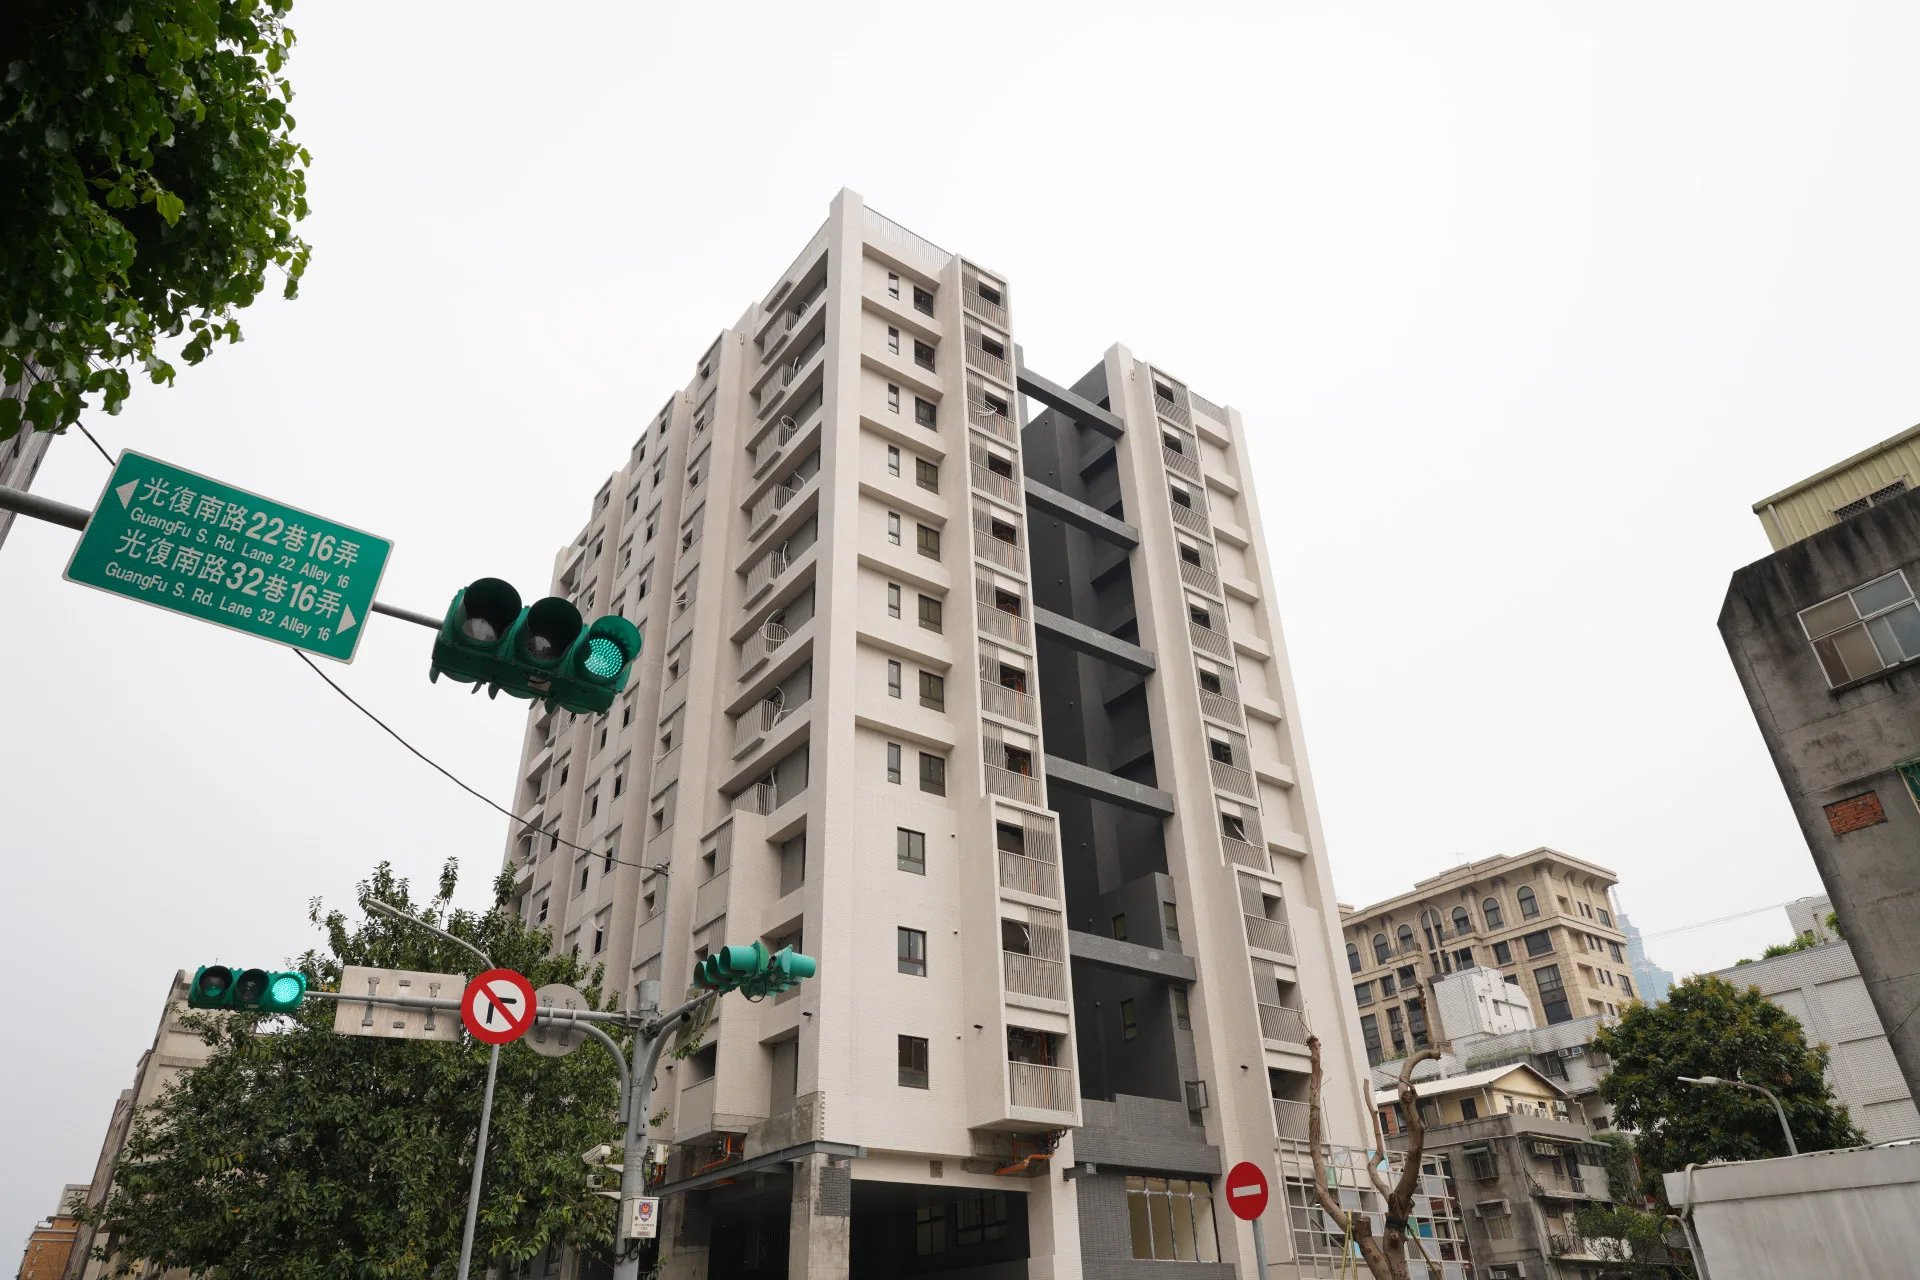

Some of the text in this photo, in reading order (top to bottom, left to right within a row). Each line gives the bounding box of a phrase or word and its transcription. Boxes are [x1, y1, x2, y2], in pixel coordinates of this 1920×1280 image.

[131, 507, 349, 588] GuangFu S. Rd. Lane 22 Alley 16
[139, 477, 360, 568] 光復南路22巷16弄
[105, 562, 330, 641] GuangFu S. Rd. Lane 32 Alley 16
[115, 528, 342, 618] 光復南路32巷16弄
